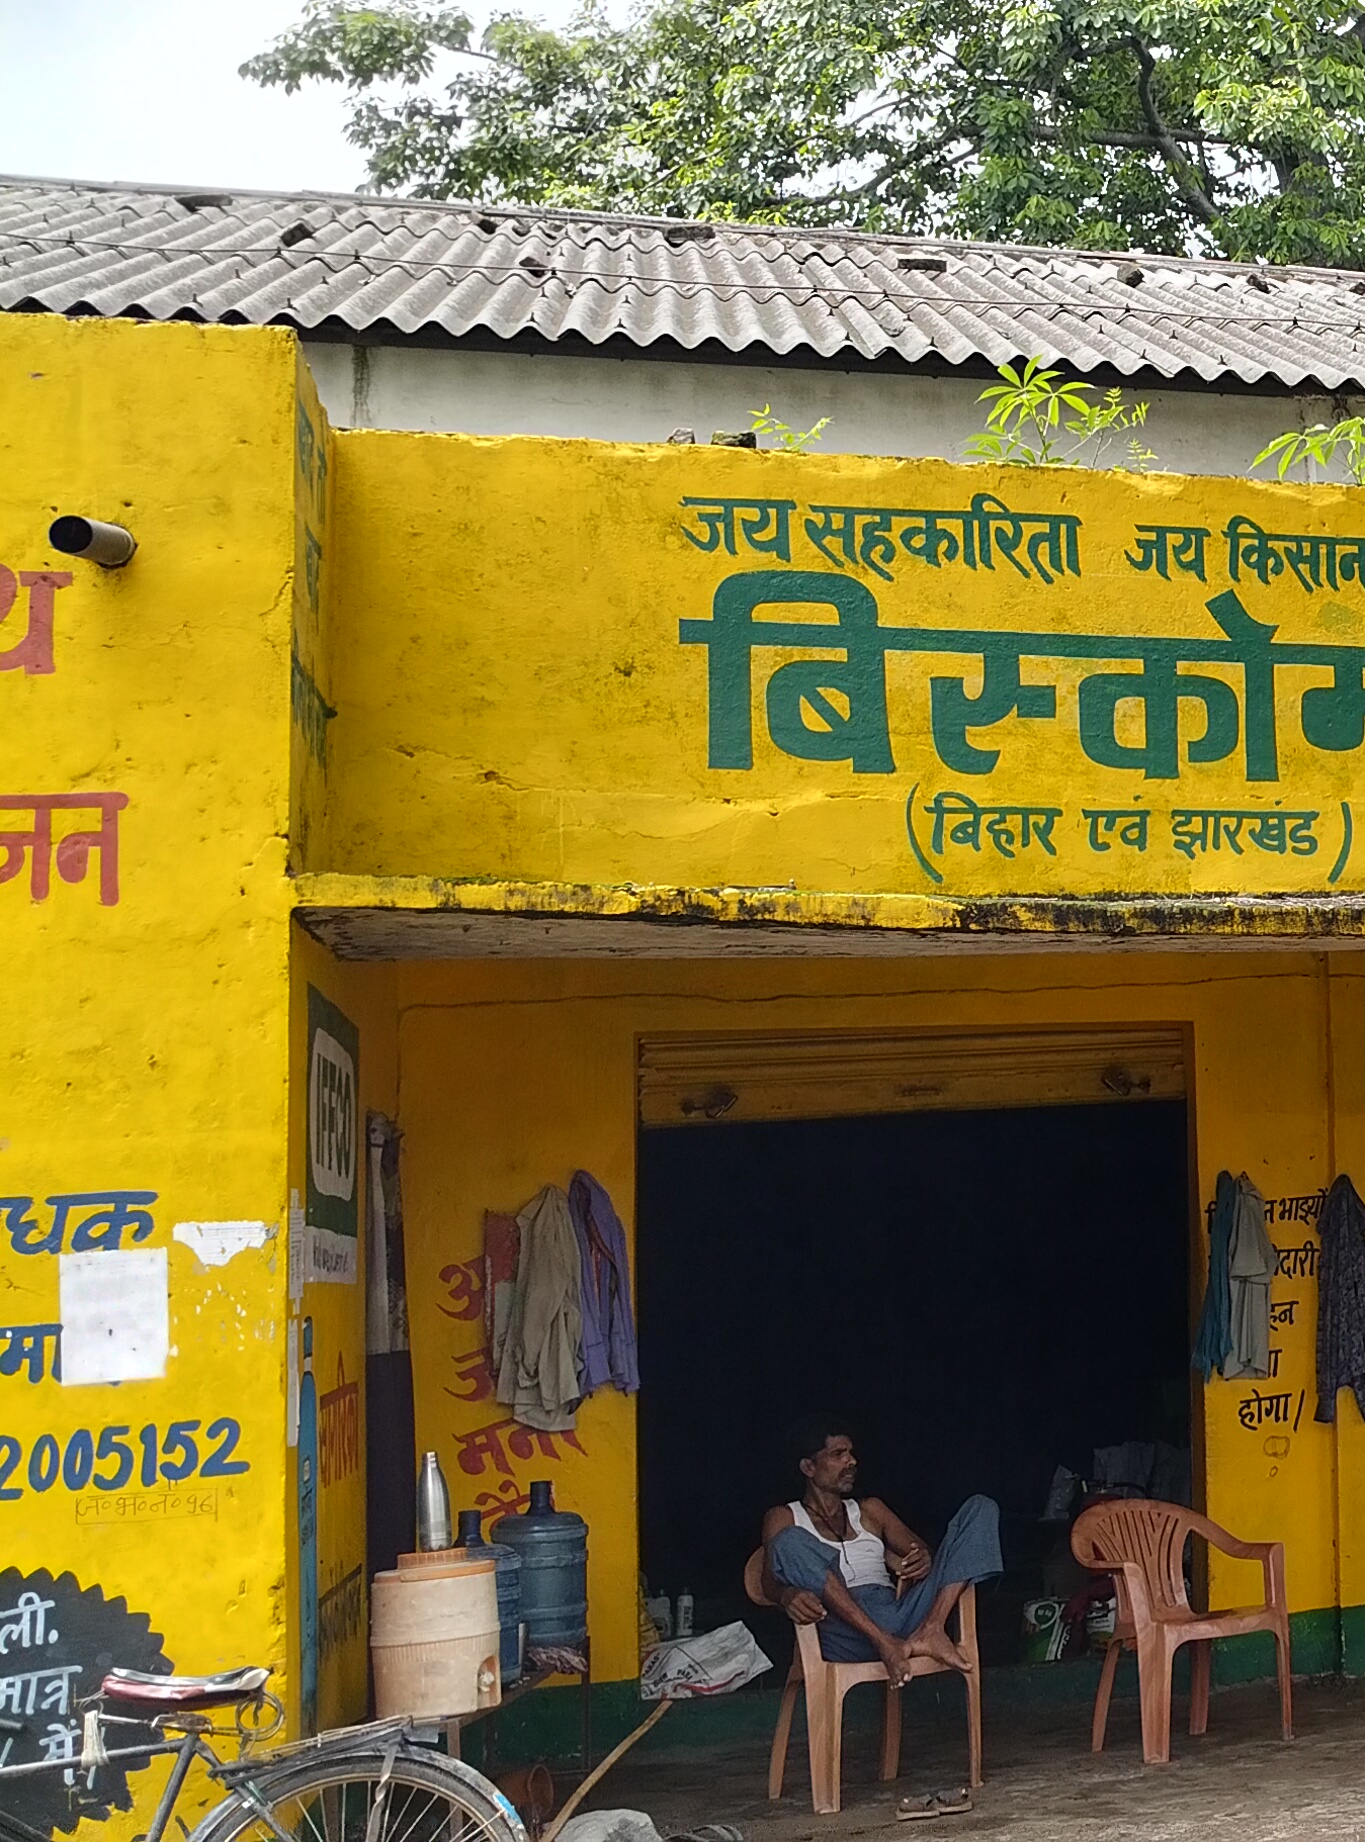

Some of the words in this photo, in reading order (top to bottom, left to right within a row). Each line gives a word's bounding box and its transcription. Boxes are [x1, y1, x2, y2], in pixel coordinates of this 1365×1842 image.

[681, 497, 796, 561] जय
[804, 493, 1083, 584] सहकारिता
[1123, 524, 1211, 581] जय
[1081, 795, 1151, 853] एवं
[316, 1052, 351, 1180] IFFCO
